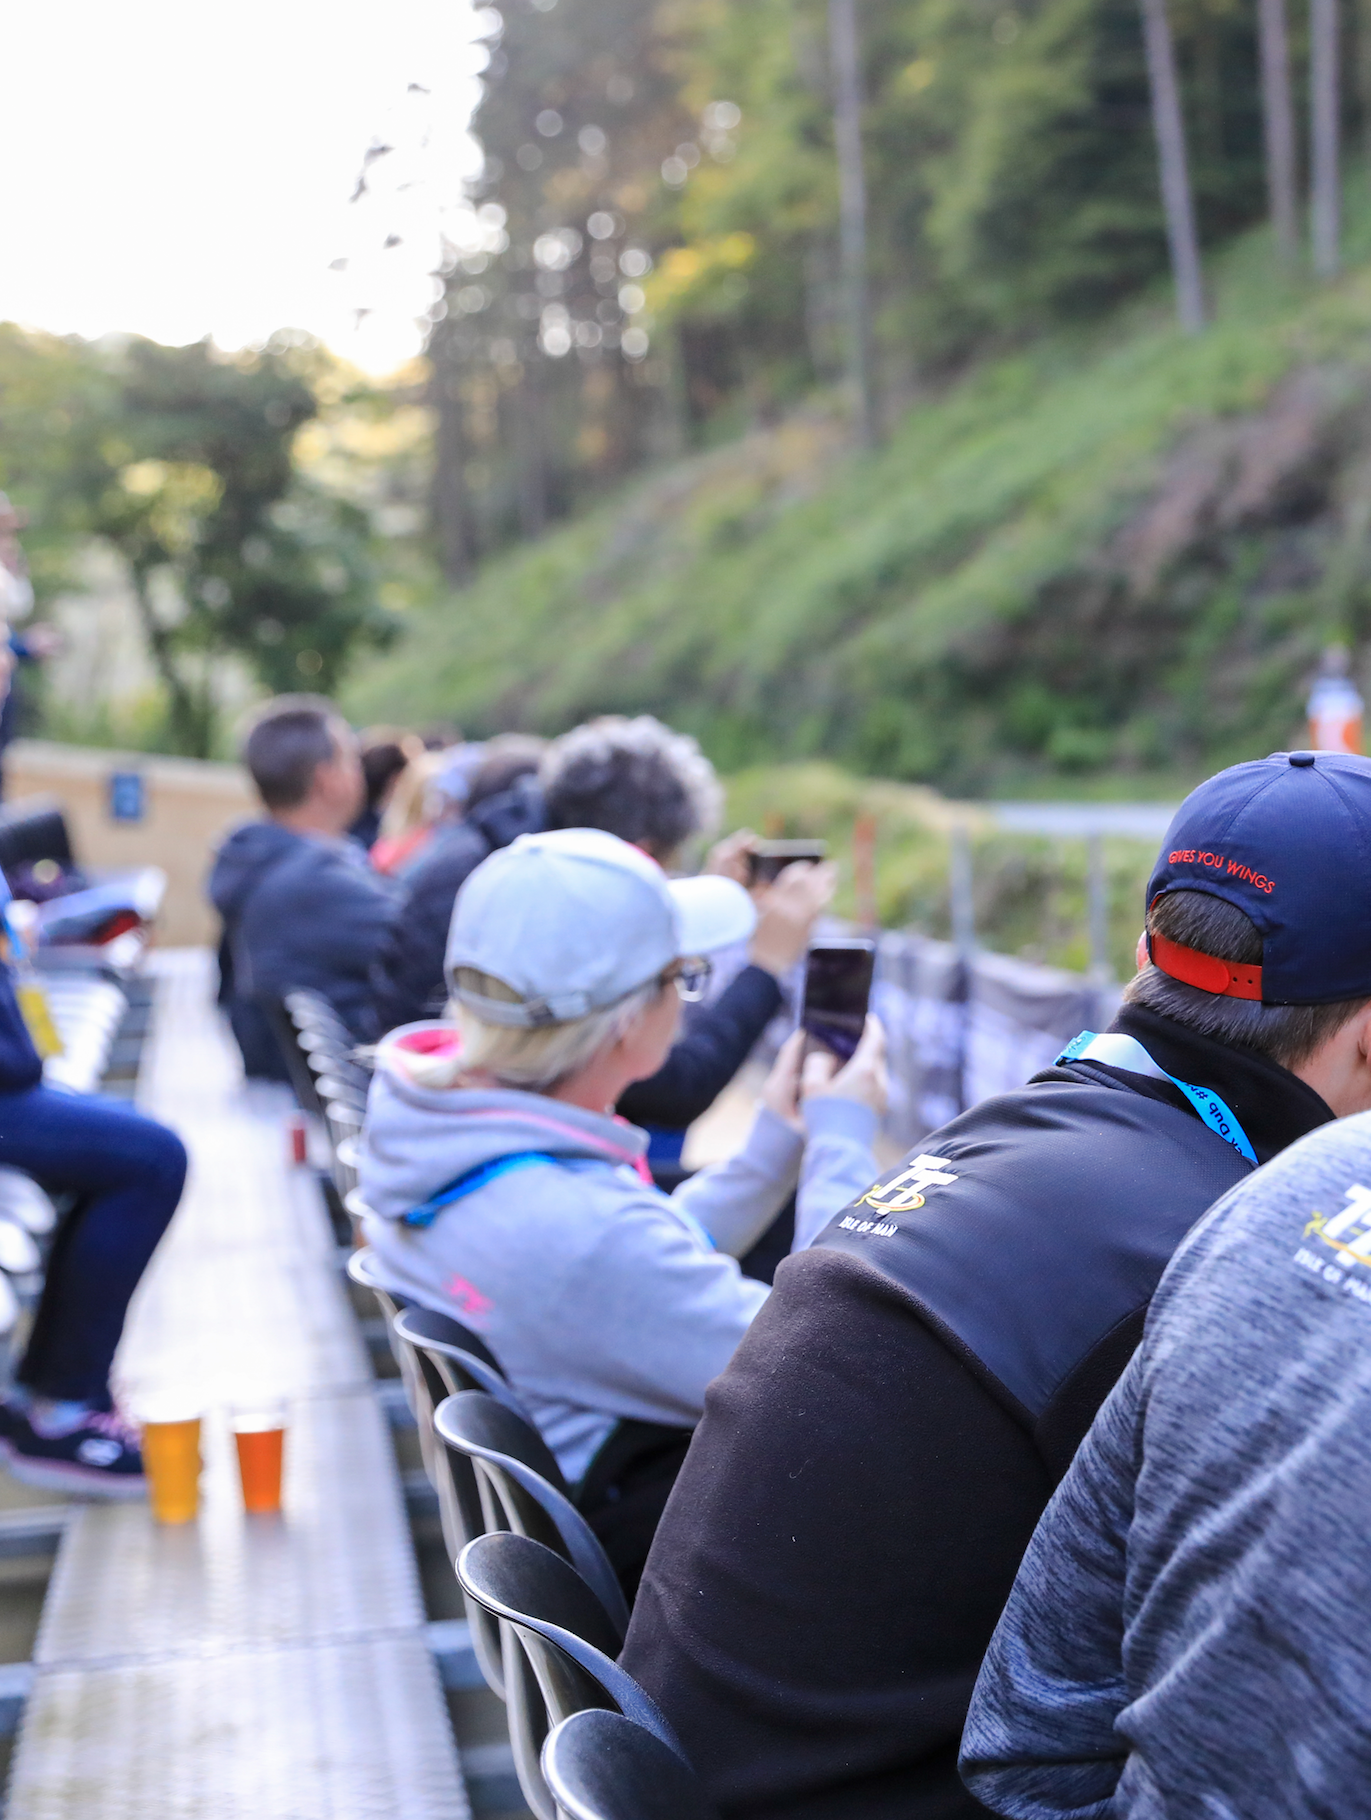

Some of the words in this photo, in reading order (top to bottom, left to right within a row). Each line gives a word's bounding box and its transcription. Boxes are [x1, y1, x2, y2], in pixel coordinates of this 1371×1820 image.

[1168, 850, 1196, 864] GIVES
[1197, 851, 1225, 869] YOU
[1227, 859, 1276, 894] WINGS
[1209, 1102, 1230, 1135] Dub
[869, 1153, 959, 1215] TT
[838, 1215, 861, 1231] ISLE
[857, 1221, 874, 1233] OF
[870, 1223, 899, 1238] MAN
[1293, 1247, 1325, 1273] ISLE
[1322, 1264, 1343, 1284] OF
